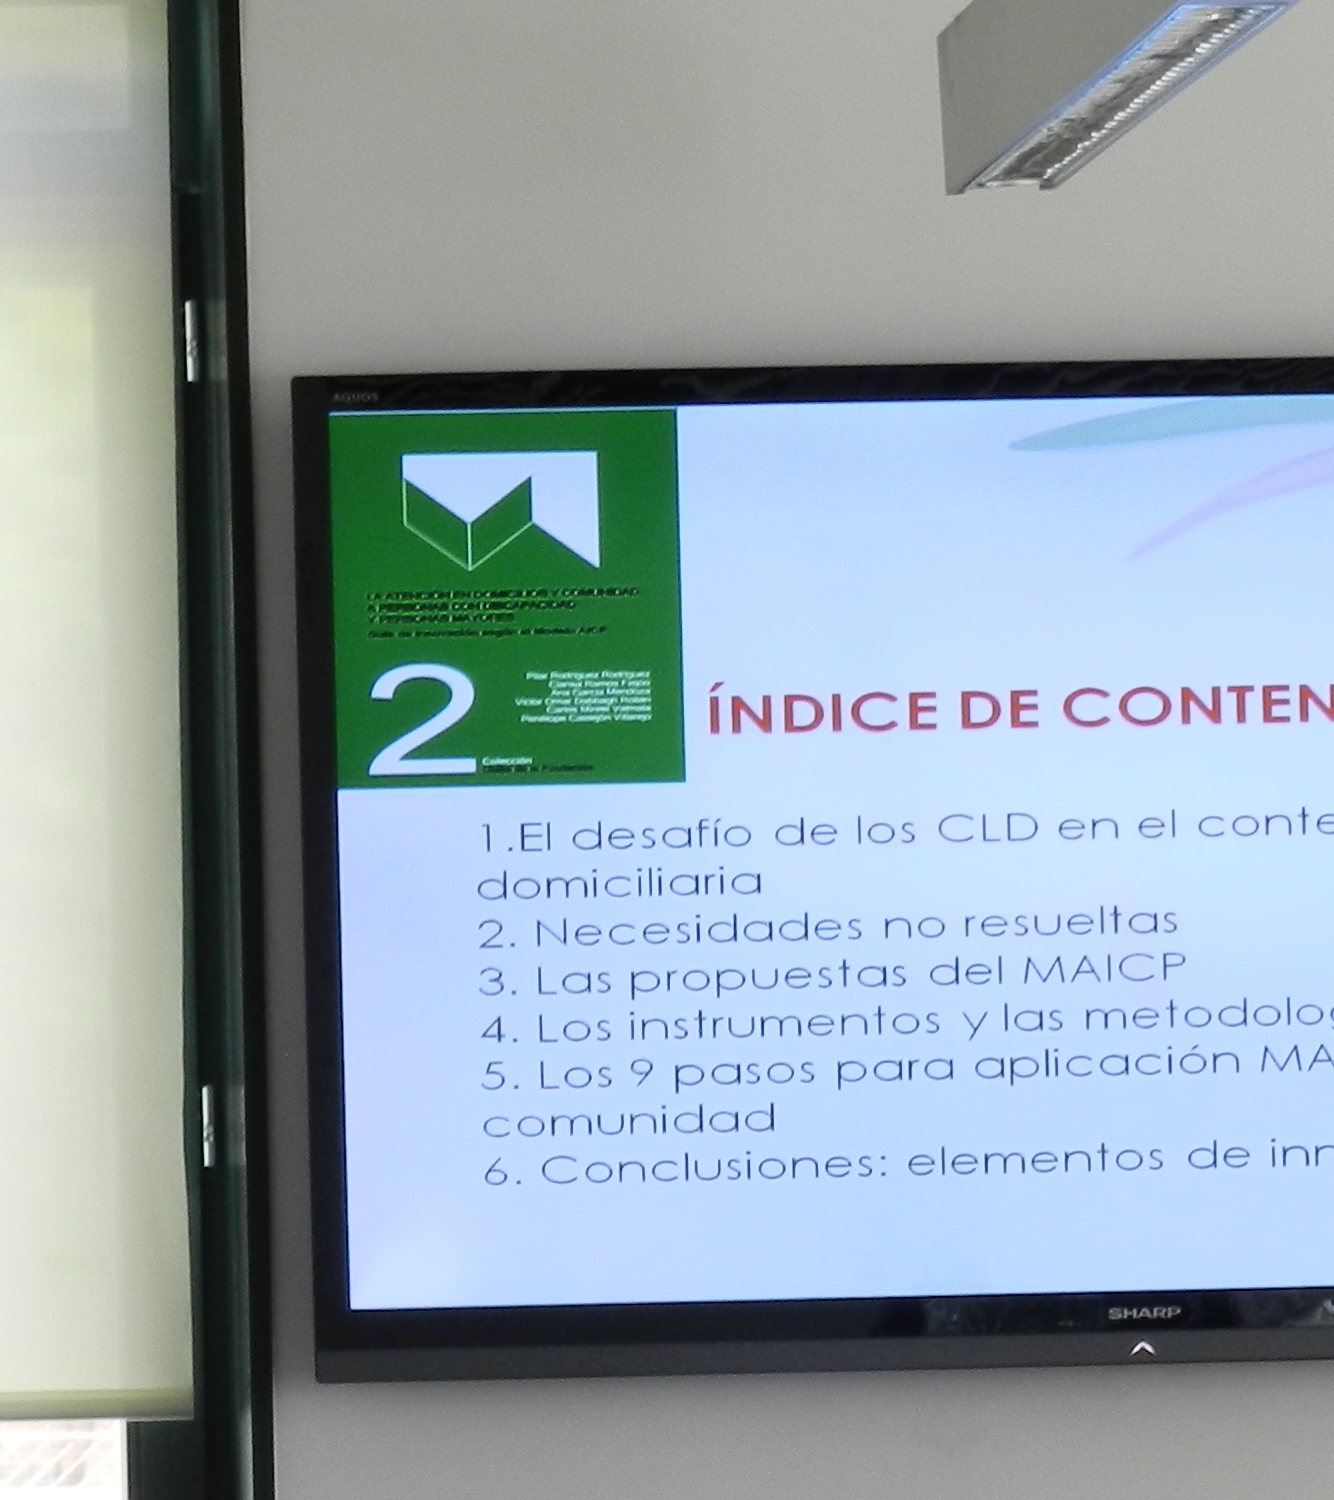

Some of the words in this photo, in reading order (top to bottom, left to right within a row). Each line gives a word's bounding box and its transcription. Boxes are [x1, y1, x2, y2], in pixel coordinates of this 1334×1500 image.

[369, 663, 476, 776] 2
[710, 681, 937, 734] ÍNDICE
[961, 689, 1039, 729] DE
[572, 818, 751, 850] desafío
[775, 817, 837, 846] de
[858, 815, 915, 844] los
[938, 813, 1038, 842] CLD
[1058, 818, 1118, 840] en
[1138, 809, 1175, 839] el
[477, 866, 761, 900] domiciliaria
[479, 919, 515, 948] 2.
[537, 912, 862, 947] Necesidades
[885, 917, 945, 939] no
[965, 905, 1177, 937] resueltas
[479, 967, 516, 996] 3.
[538, 967, 611, 995] Las
[631, 959, 906, 1001] propuestas
[930, 955, 1002, 986] del
[1024, 953, 1186, 984] MAICP
[481, 1016, 518, 1043] 4.
[539, 1014, 611, 1043] Los
[630, 1005, 940, 1040] instrumentos
[963, 1011, 988, 1041] y
[1004, 1003, 1063, 1032] las
[481, 1061, 519, 1090] 5.
[540, 1061, 612, 1089] Los
[630, 1059, 653, 1087] 9
[675, 1062, 814, 1094] pasos
[837, 1059, 953, 1090] para
[975, 1044, 1239, 1086] aplicación
[483, 1102, 774, 1138] comunidad
[485, 1157, 521, 1186] 6.
[542, 1151, 886, 1184] Conclusiones:
[908, 1142, 1163, 1176] elementos
[1188, 1140, 1250, 1169] de
[1108, 1306, 1182, 1320] SHARP
